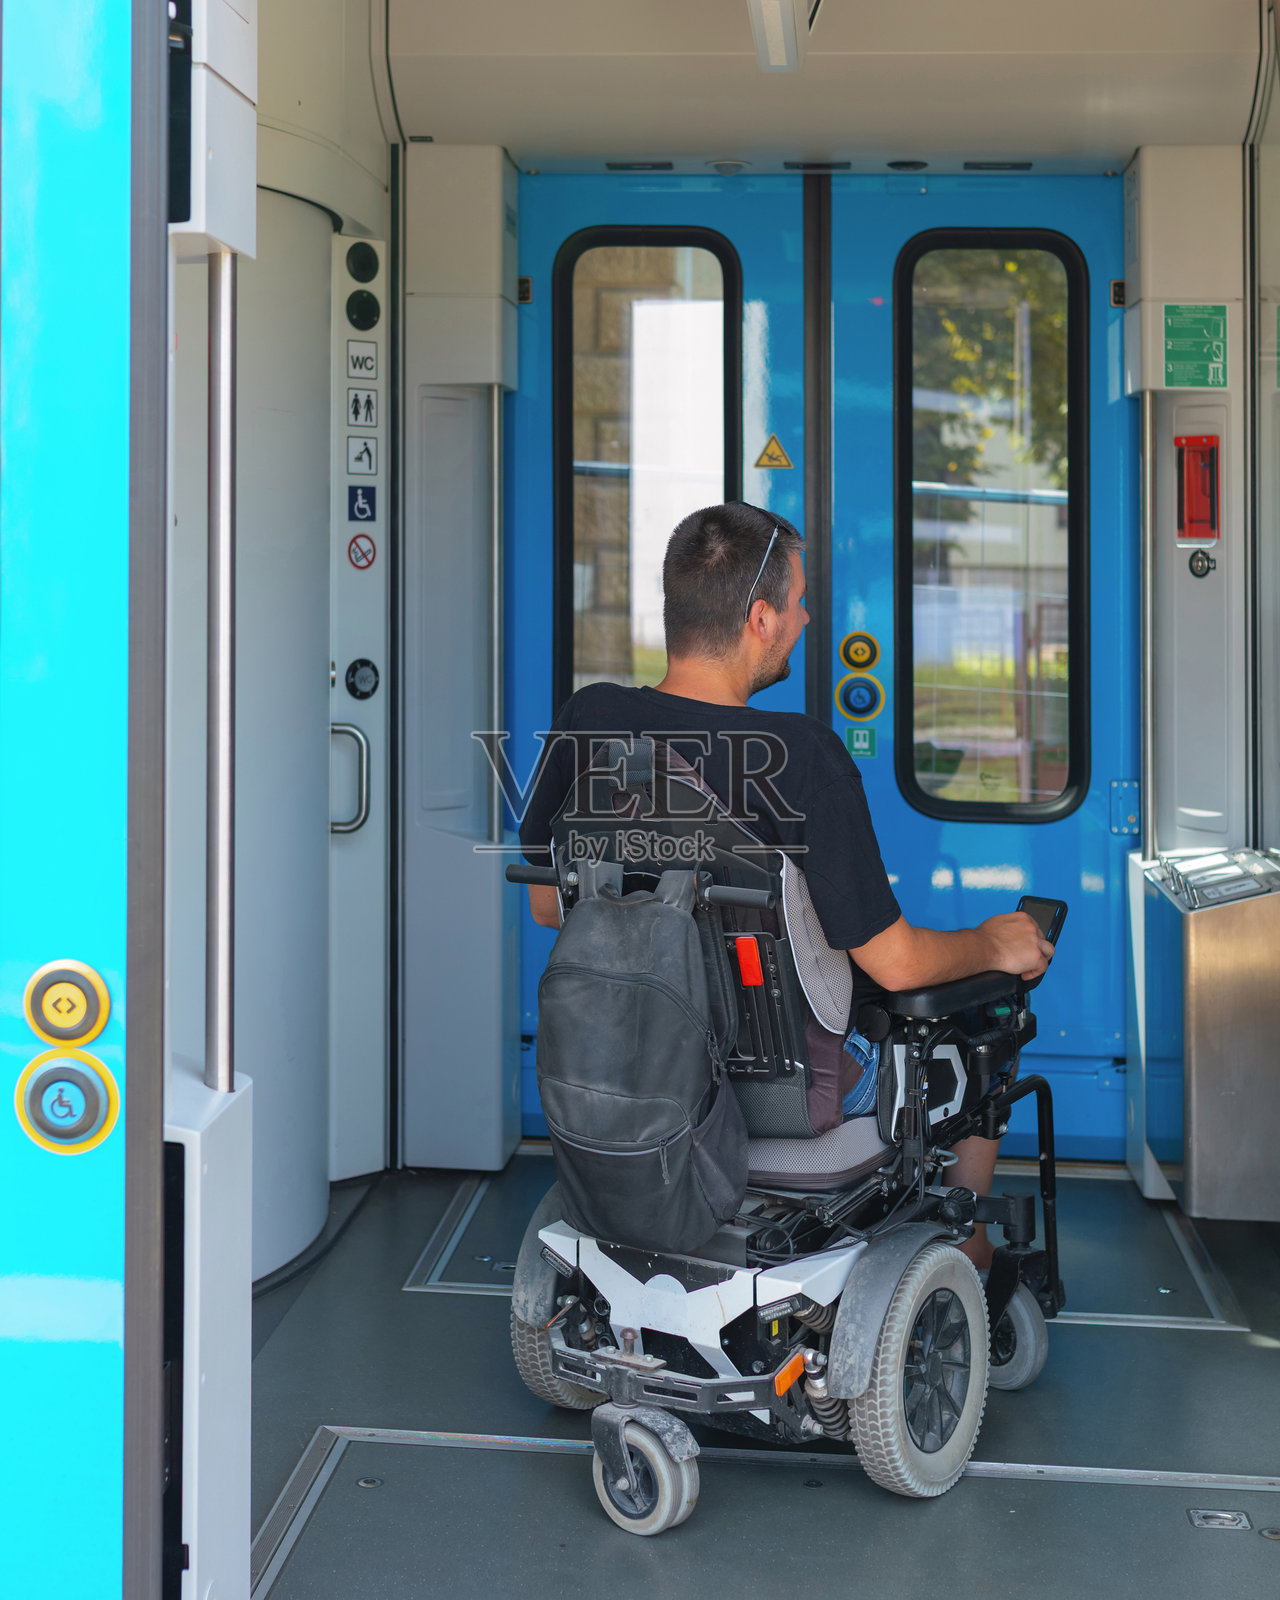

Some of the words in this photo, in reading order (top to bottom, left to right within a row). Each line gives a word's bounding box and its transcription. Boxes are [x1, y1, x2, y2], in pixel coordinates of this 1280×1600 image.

[1167, 340, 1173, 350] 2
[351, 355, 374, 371] WC
[1167, 364, 1173, 373] 3
